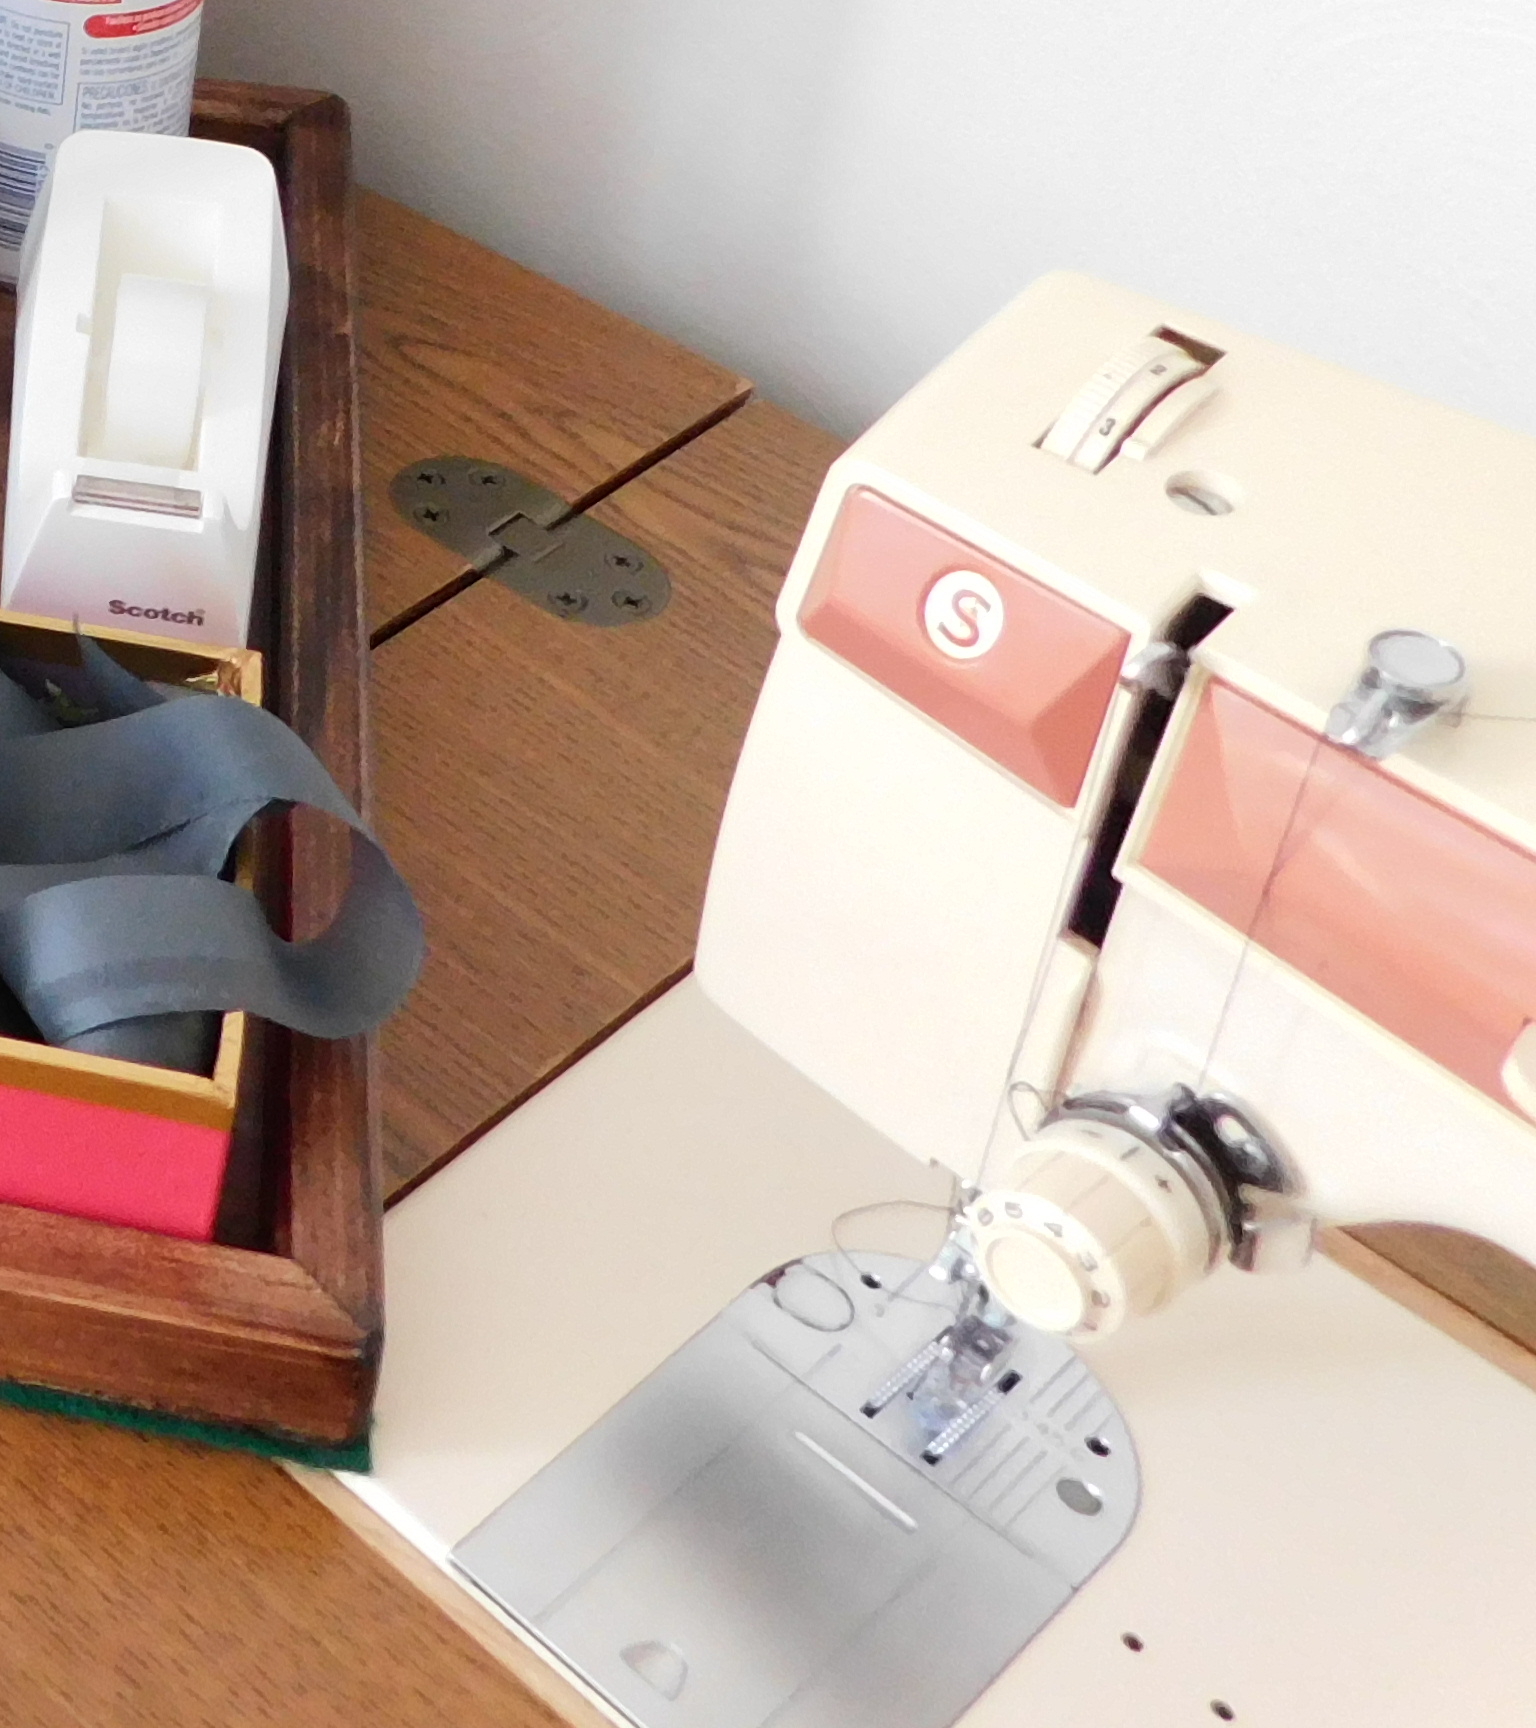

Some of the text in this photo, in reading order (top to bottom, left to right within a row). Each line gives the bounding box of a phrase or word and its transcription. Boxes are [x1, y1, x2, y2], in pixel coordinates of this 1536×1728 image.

[1098, 417, 1117, 437] 3
[108, 599, 205, 627] Scotch
[935, 588, 992, 648] S
